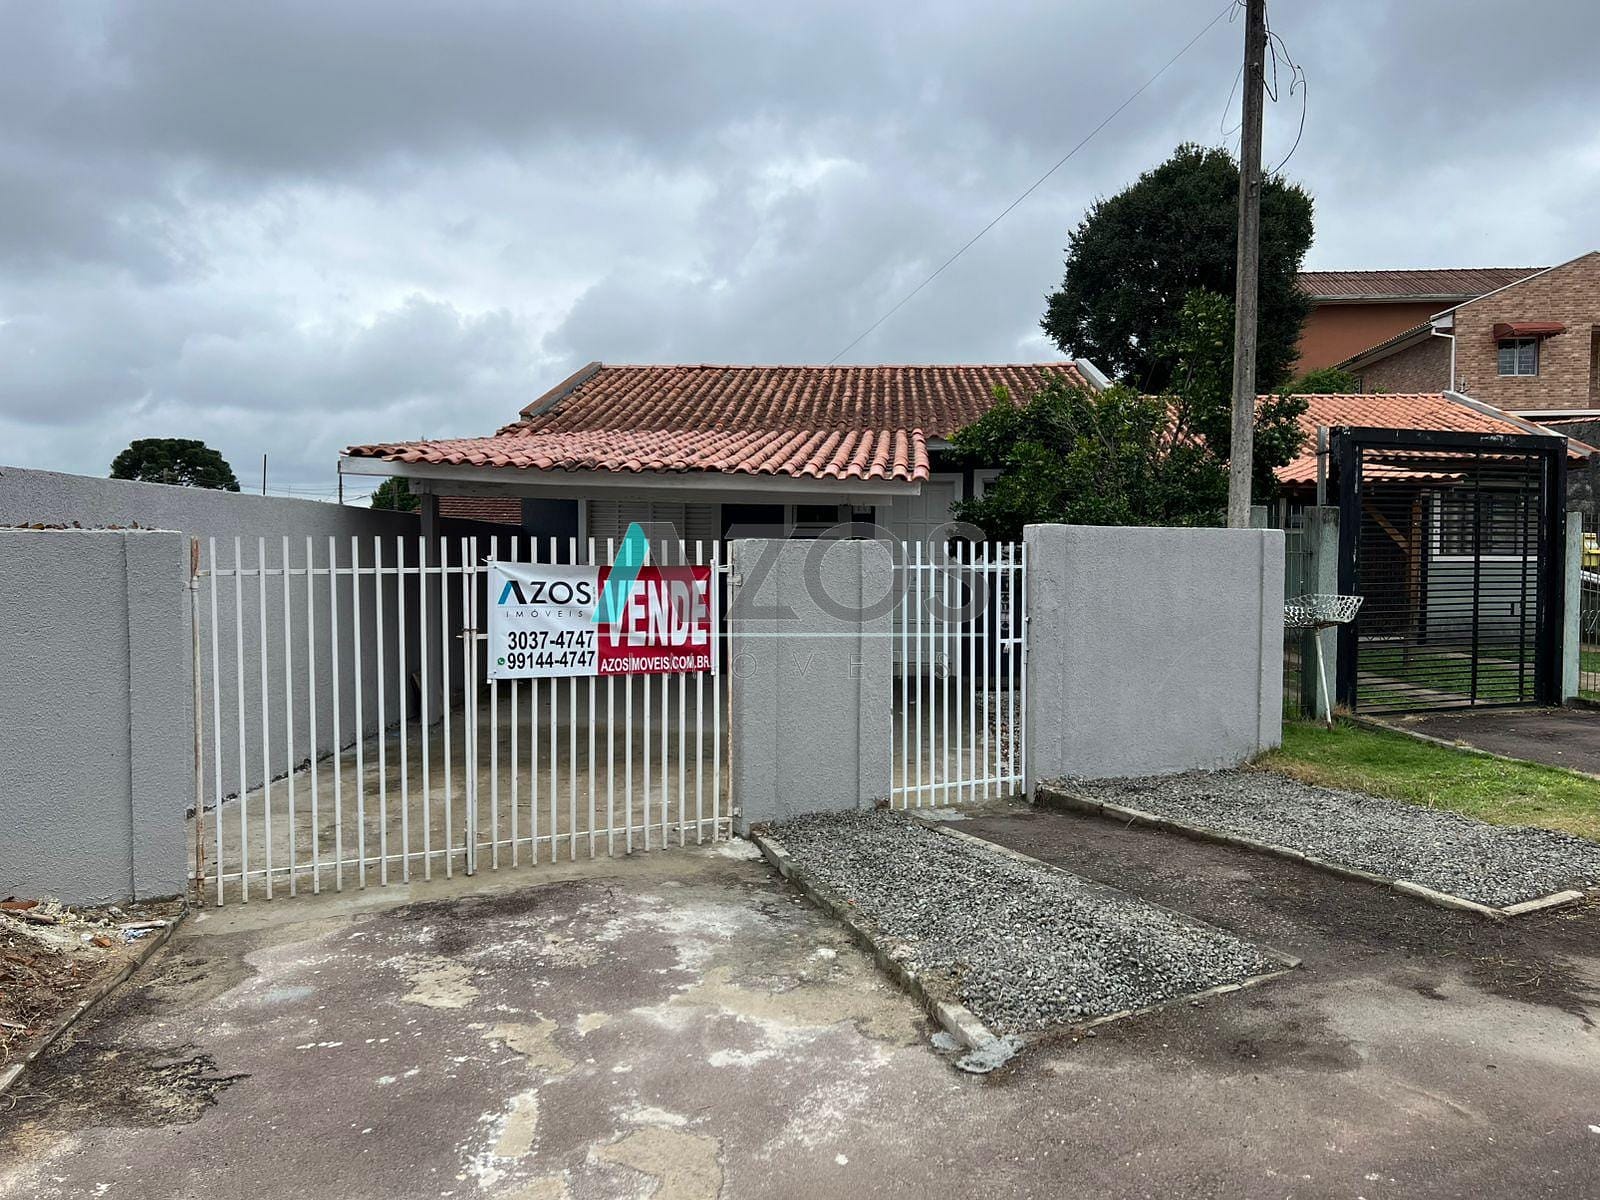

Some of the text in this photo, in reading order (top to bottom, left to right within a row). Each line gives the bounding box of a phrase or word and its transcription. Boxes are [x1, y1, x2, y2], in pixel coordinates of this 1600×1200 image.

[497, 580, 592, 605] AZOS
[506, 609, 583, 618] IMÓVEIS
[604, 579, 707, 647] VENDE
[508, 630, 595, 650] 3037-4747
[507, 651, 595, 670] 99144-4747
[600, 655, 710, 672] AZOSIMOVEIS.COM.BR
